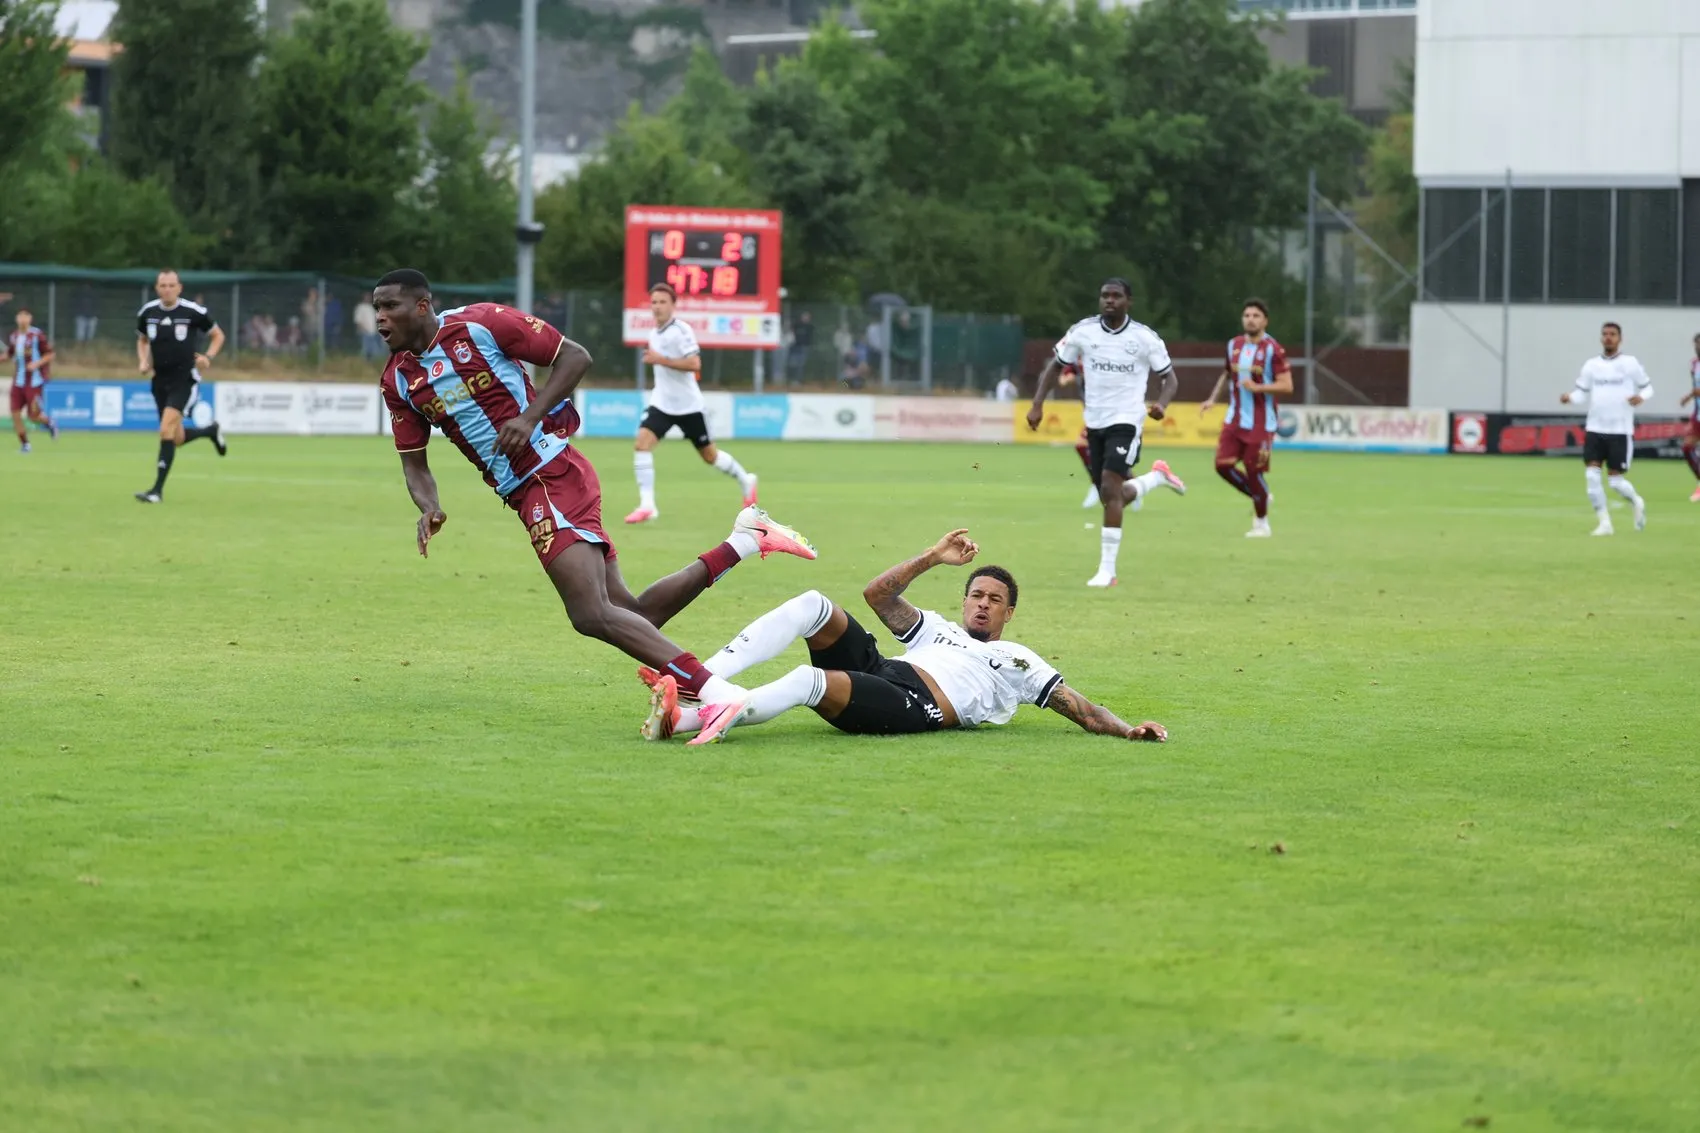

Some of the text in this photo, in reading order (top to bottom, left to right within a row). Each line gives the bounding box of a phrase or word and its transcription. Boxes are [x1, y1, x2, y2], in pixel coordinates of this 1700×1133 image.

[664, 230, 685, 260] 0
[721, 232, 742, 262] 2
[1091, 357, 1135, 373] indeed
[422, 371, 492, 419] papara
[1306, 412, 1356, 437] WDL
